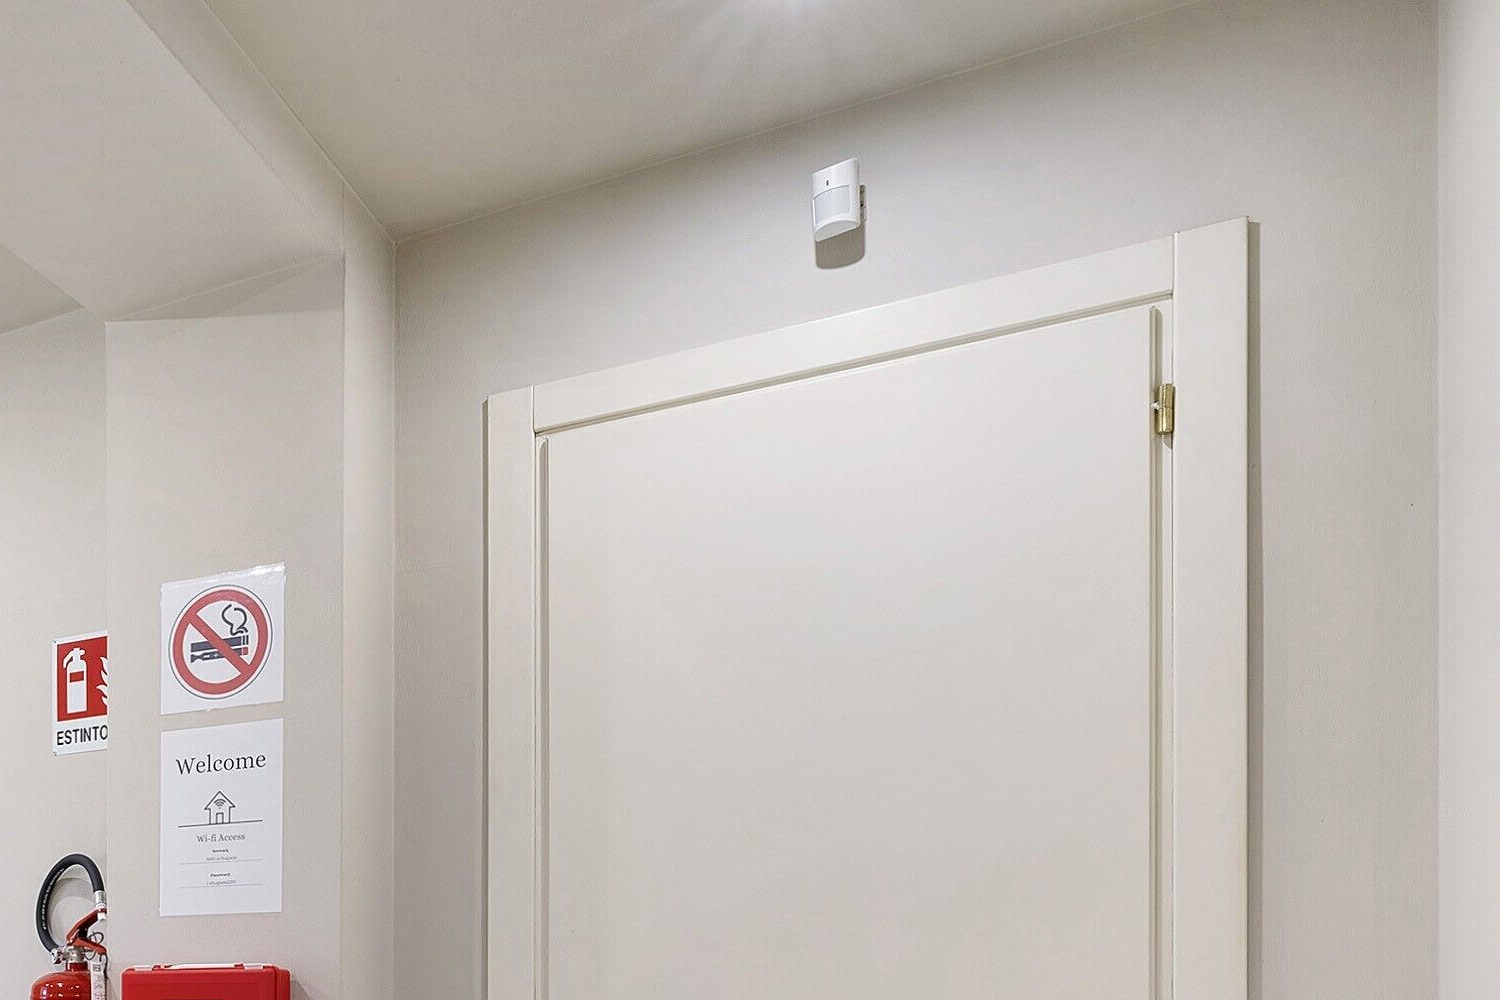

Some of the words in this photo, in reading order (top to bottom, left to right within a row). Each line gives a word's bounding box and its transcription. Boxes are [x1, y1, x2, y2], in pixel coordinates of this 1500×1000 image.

[57, 725, 108, 745] ESTINTO
[176, 754, 266, 775] Welcome
[196, 834, 217, 842] Wi-fi
[218, 833, 246, 842] Access
